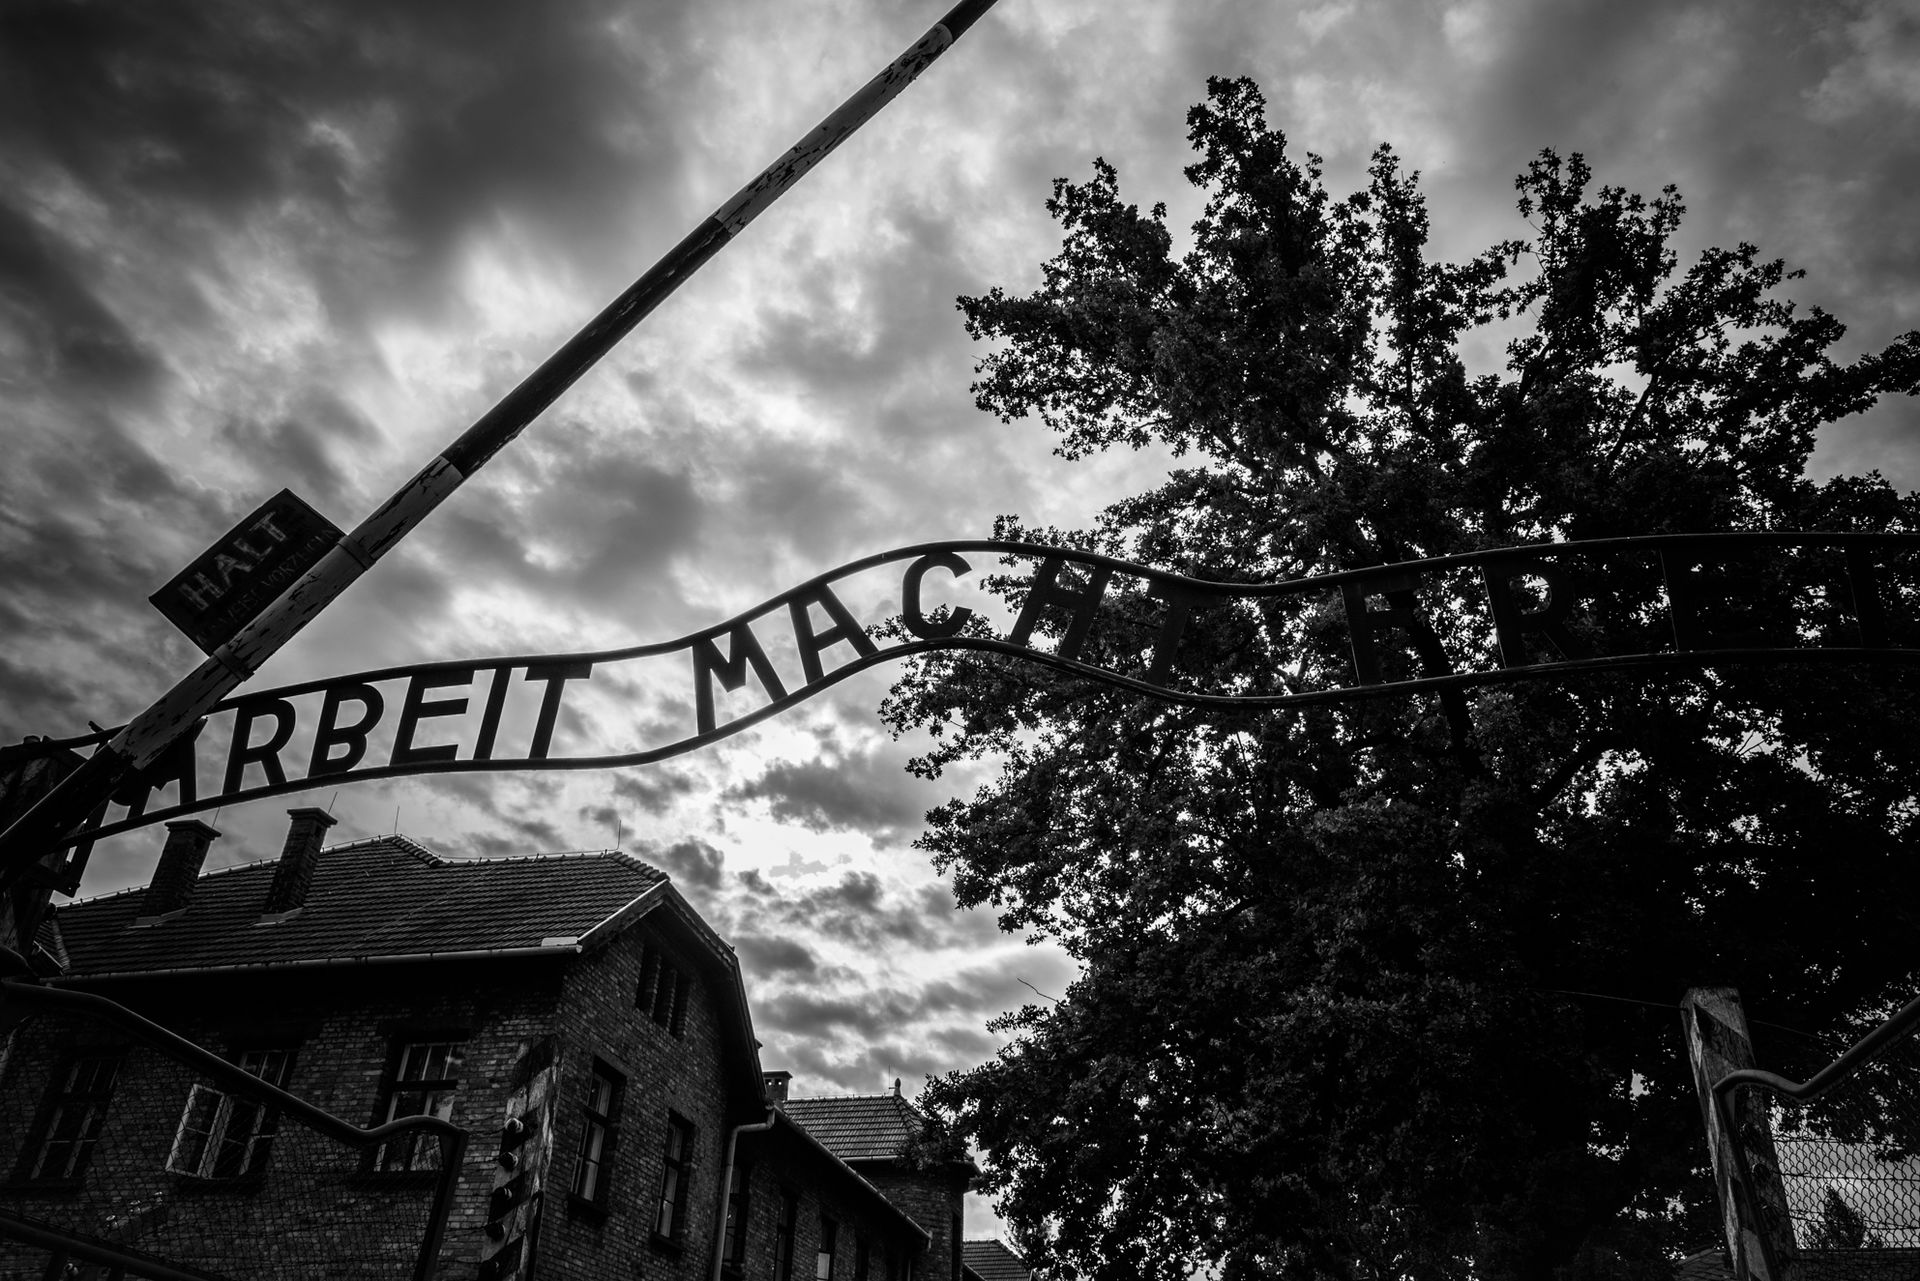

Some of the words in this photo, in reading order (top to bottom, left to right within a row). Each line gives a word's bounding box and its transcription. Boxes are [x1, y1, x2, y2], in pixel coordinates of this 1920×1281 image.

[177, 510, 287, 611] HALT
[126, 663, 592, 818] ARBEIT
[692, 551, 1229, 736] MACHT
[1340, 541, 1888, 688] FREI
